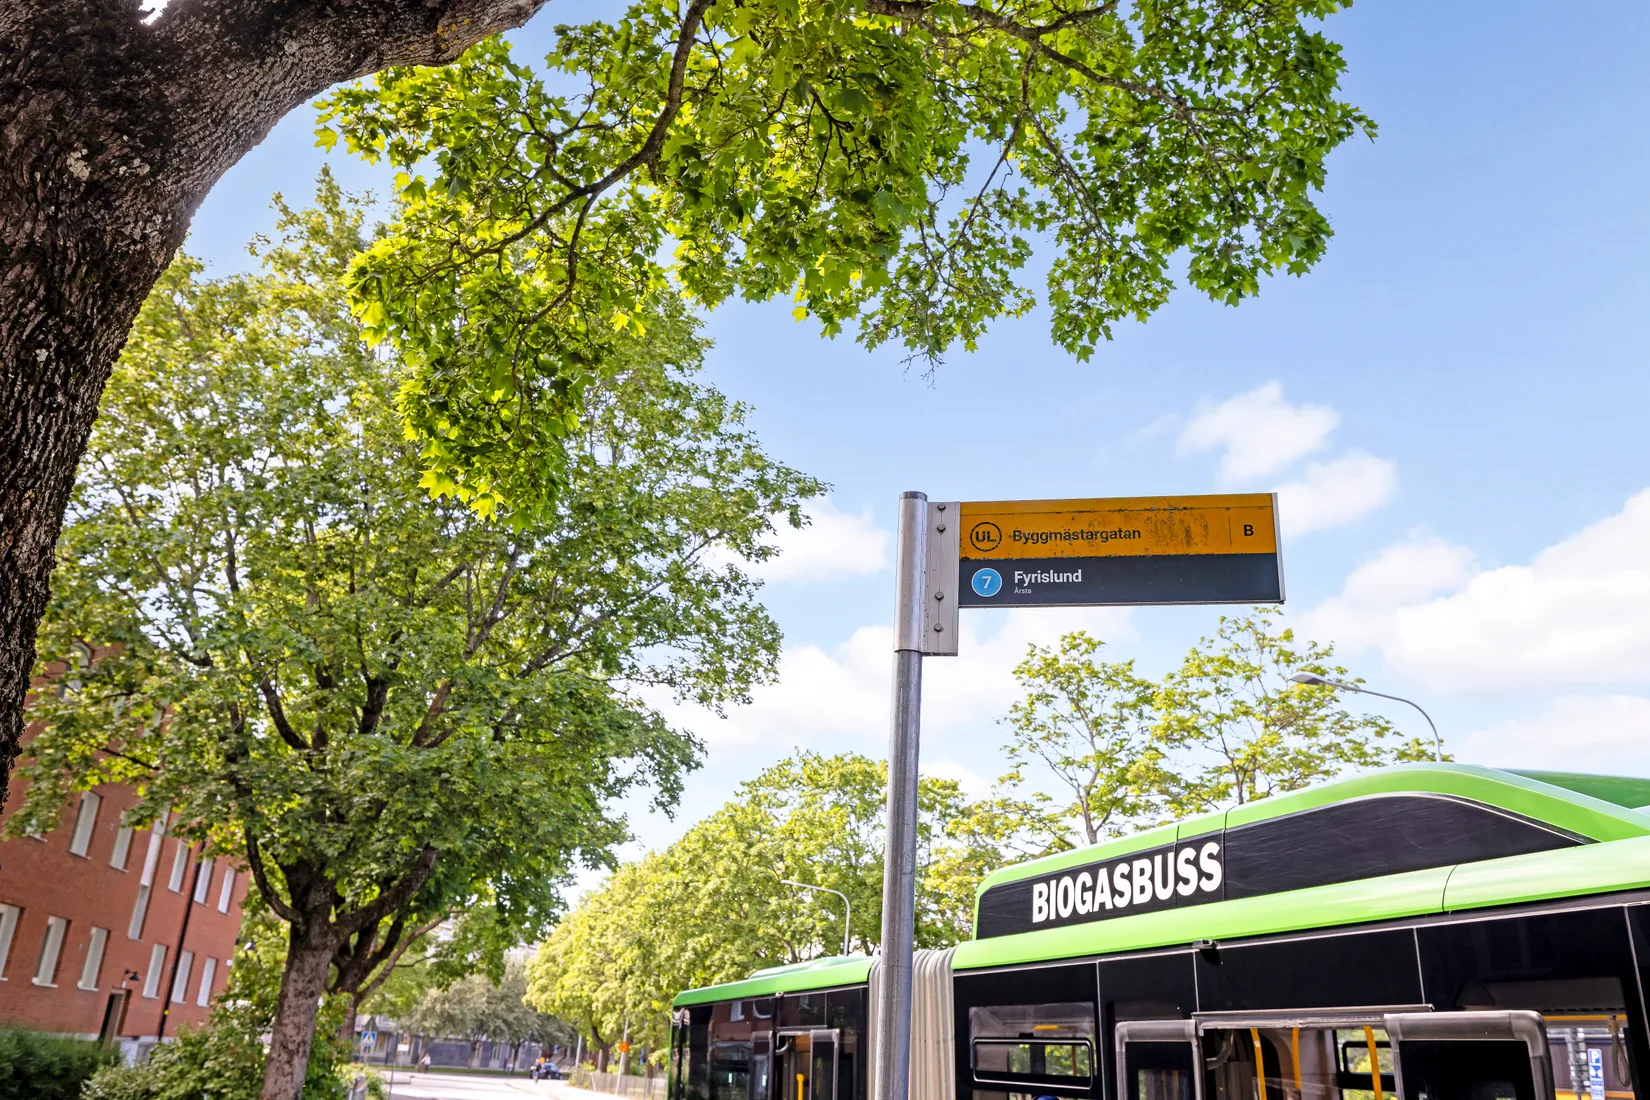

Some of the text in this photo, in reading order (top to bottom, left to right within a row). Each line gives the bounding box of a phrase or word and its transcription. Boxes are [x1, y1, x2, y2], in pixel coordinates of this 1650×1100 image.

[975, 530, 997, 543] UL
[1012, 528, 1141, 544] Byggmästargatan
[1243, 524, 1254, 537] B
[981, 576, 992, 589] 7
[1014, 569, 1082, 585] Fyrislund
[1032, 842, 1222, 923] BIOGASBUSS
